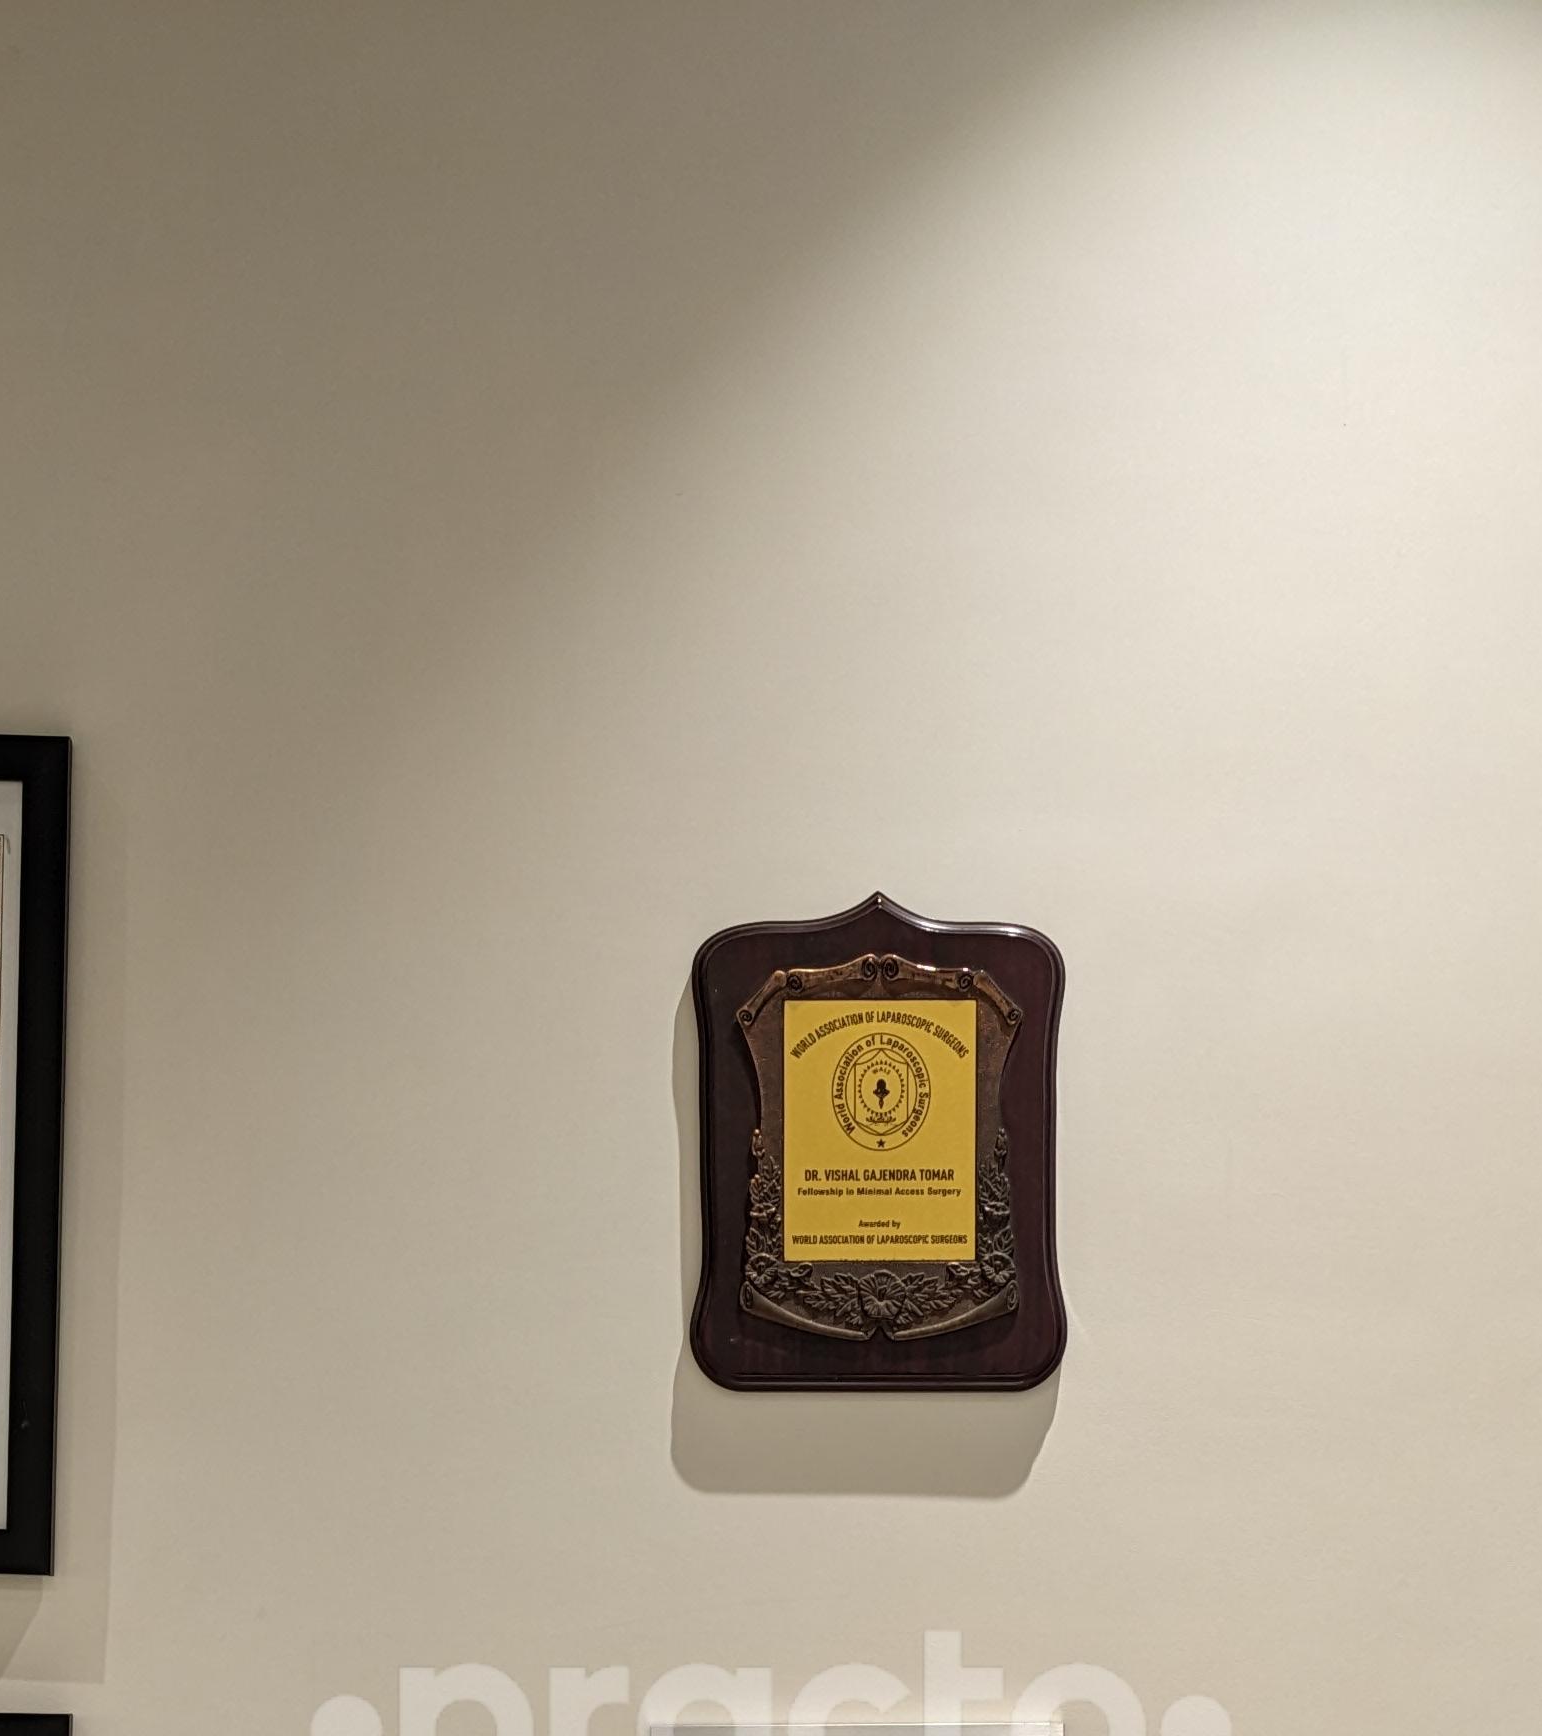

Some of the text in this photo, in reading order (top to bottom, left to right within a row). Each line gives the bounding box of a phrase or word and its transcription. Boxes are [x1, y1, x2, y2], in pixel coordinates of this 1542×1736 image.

[790, 1011, 969, 1060] WORLD ASSOCIATION OF LAPAROSCOPIC SURGEONS
[834, 1034, 929, 1137] World Association of Laparoscopic Surgeons
[804, 1169, 954, 1181] DR. VISHAL GAJENDRA TOMAR
[797, 1188, 843, 1197] Fellowship
[857, 1188, 892, 1196] Minimal
[927, 1187, 961, 1197] Surgery
[858, 1220, 901, 1229] Awarded by
[792, 1234, 968, 1244] WORLD ASSOCIATION OF LAPAROSCOPIC SURGEONS
